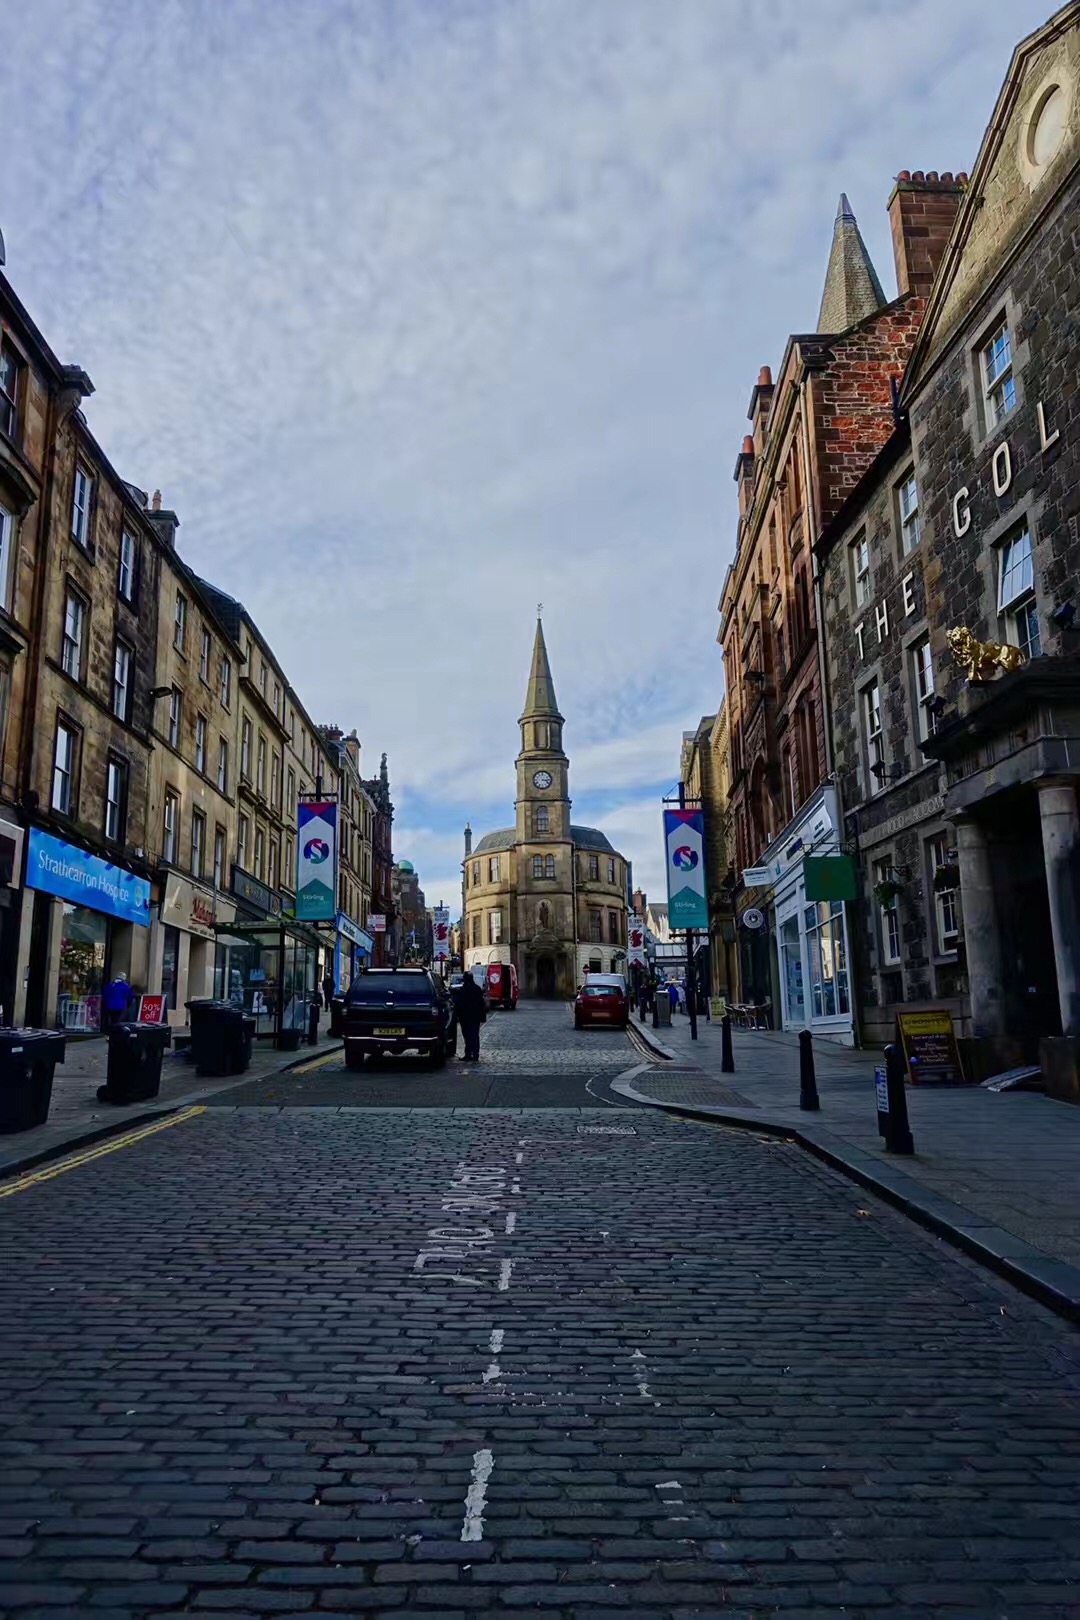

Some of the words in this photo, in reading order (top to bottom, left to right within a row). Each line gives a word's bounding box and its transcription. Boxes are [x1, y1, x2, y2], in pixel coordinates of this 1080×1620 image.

[855, 571, 916, 660] THE
[953, 401, 1060, 538] GOL
[38, 849, 97, 888] Strathcarron
[99, 874, 130, 902] Hospice
[142, 1003, 160, 1012] 50%
[144, 1010, 156, 1020] off
[441, 1161, 507, 1214] LOADING
[408, 1227, 497, 1286] ONLY
